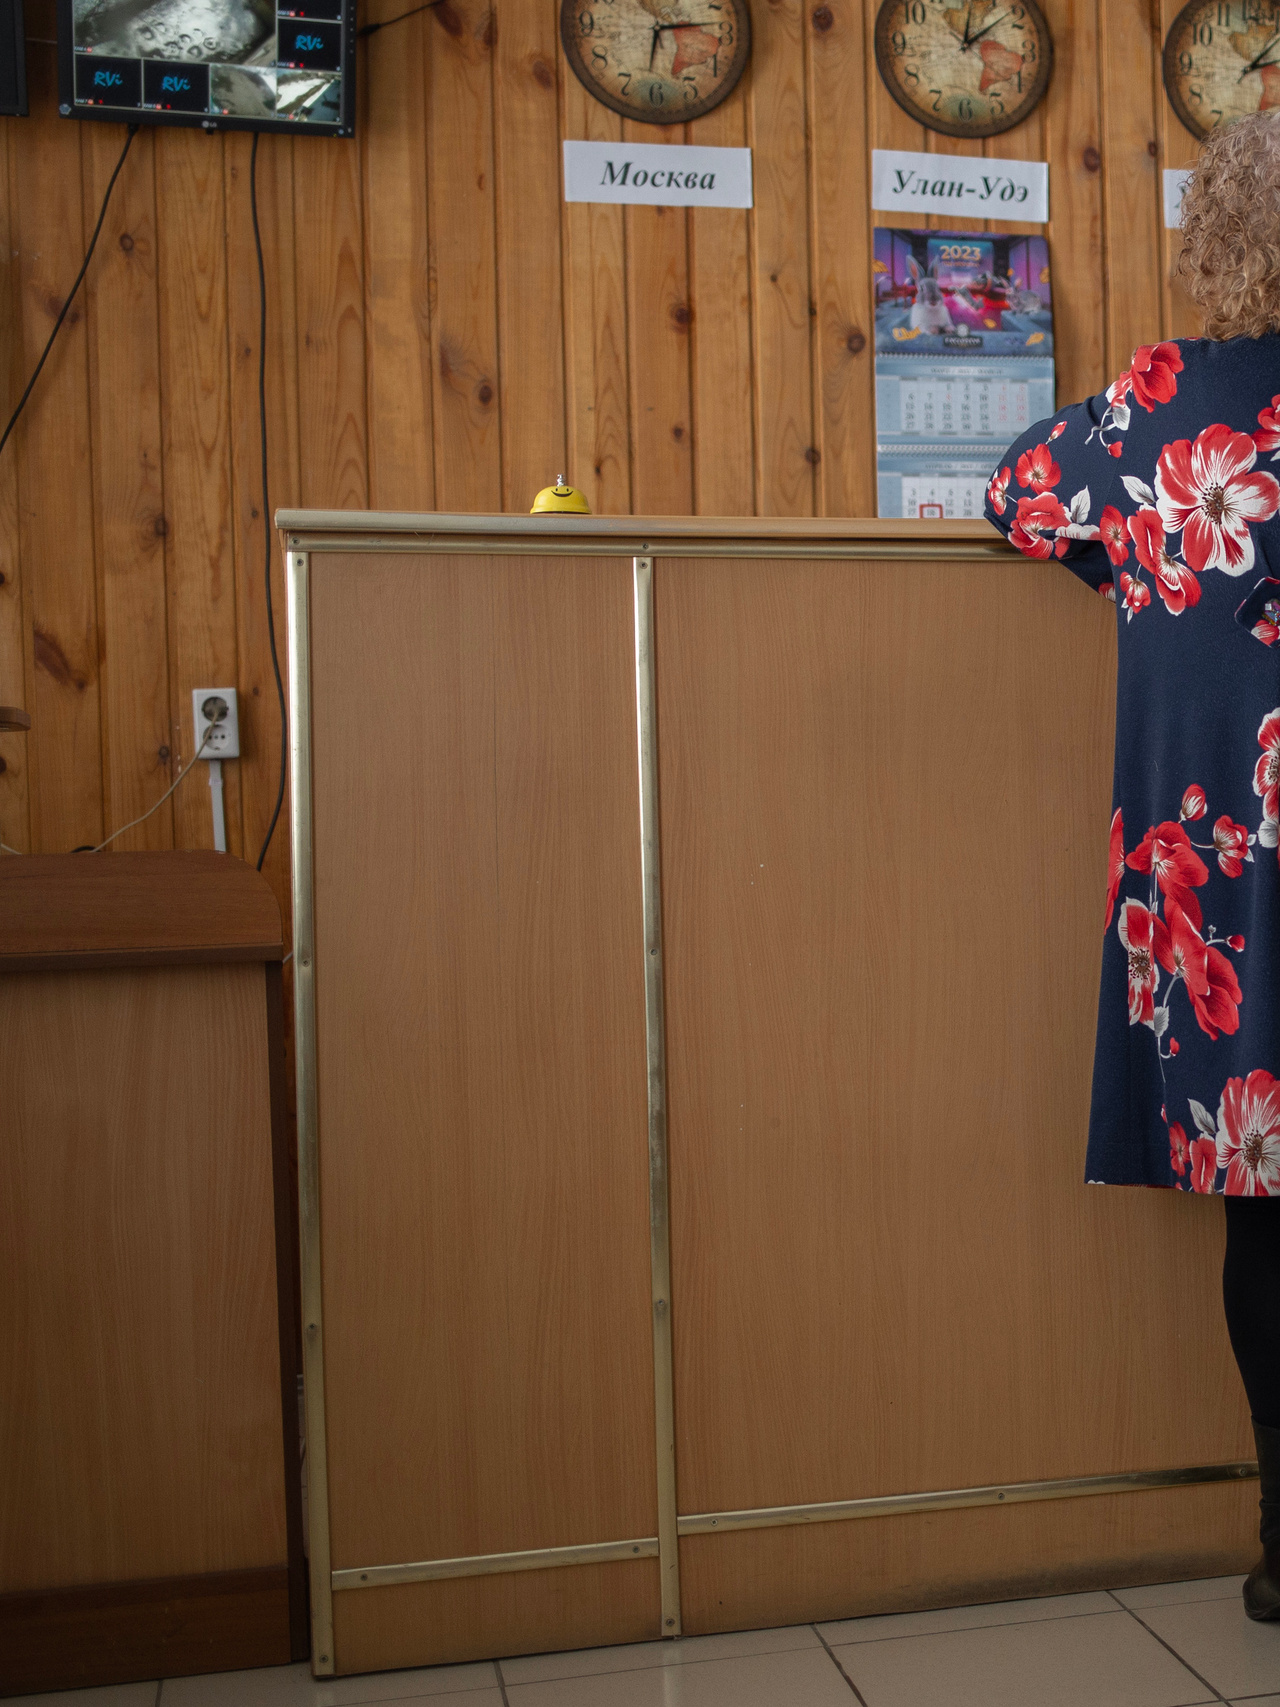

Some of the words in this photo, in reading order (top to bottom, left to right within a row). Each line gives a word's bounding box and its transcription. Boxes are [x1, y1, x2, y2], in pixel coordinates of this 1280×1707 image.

[579, 10, 594, 36] 9
[904, 0, 926, 24] 10
[1217, 3, 1231, 27] 11
[718, 22, 733, 46] 3
[892, 31, 906, 55] 9
[1192, 23, 1212, 46] 10
[591, 45, 608, 70] 8
[1022, 40, 1036, 62] 3
[904, 63, 920, 87] 8
[1179, 52, 1192, 75] 9
[618, 72, 632, 96] 7
[649, 82, 664, 108] 6
[683, 76, 698, 102] 5
[1188, 84, 1204, 106] 8
[929, 89, 942, 111] 7
[959, 99, 973, 121] 6
[989, 92, 1004, 115] 5
[600, 160, 716, 189] Москва
[893, 169, 1028, 202] Улан-Удэ
[940, 245, 981, 261] 2023
